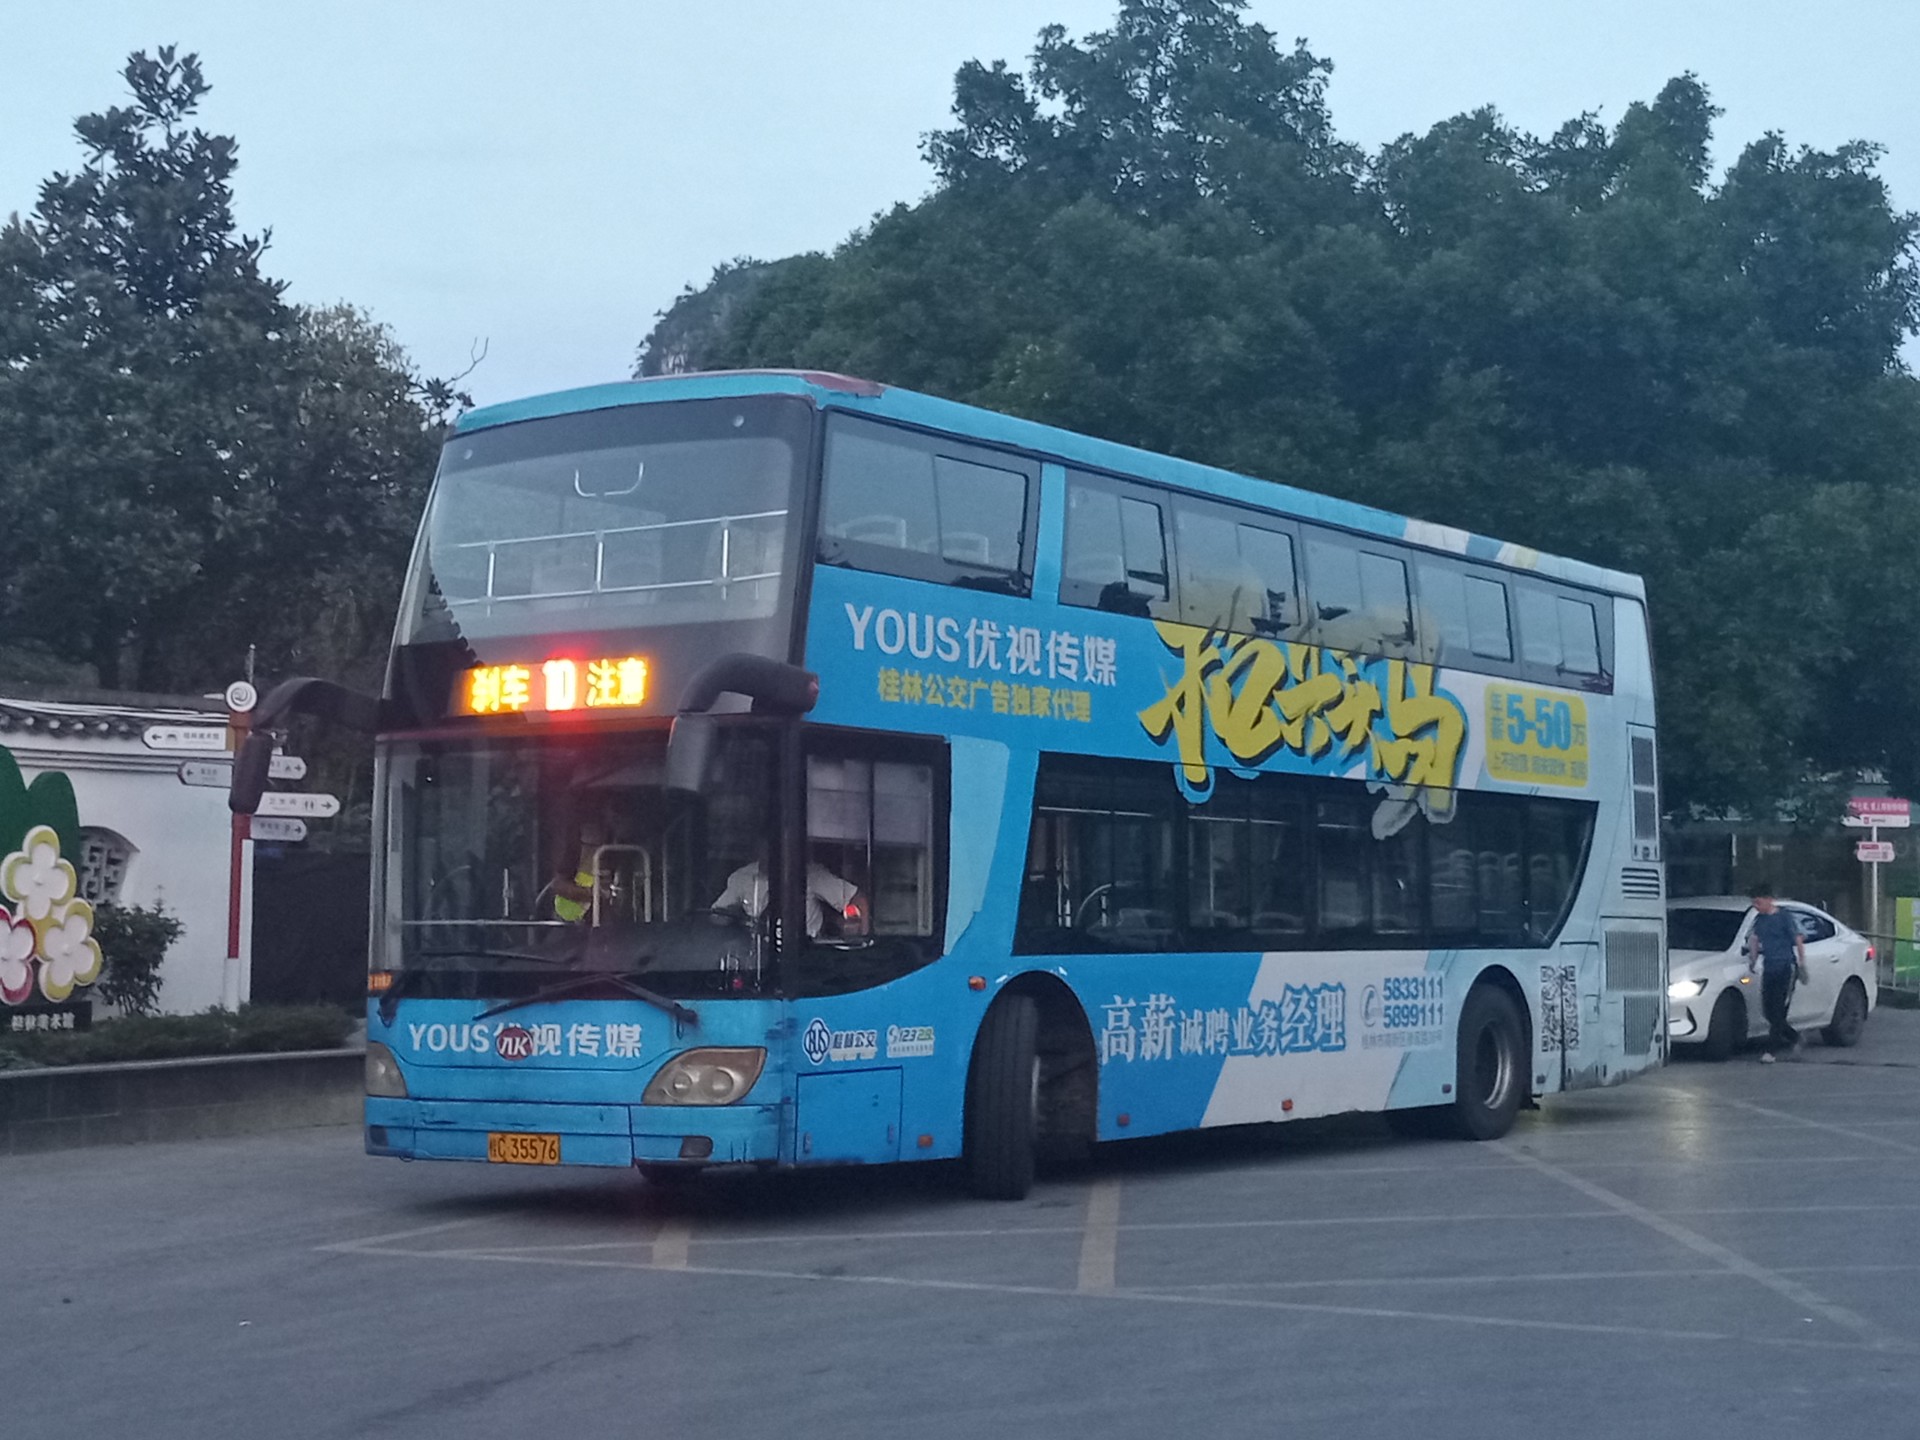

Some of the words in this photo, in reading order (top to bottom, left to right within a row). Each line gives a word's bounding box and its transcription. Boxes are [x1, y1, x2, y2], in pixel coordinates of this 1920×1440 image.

[844, 602, 1117, 687] YOUS优视传媒
[472, 664, 530, 712] 刹车
[585, 657, 647, 706] 注意
[877, 666, 1092, 722] 桂林公交广告独家代理
[1383, 976, 1443, 1001] 5833111
[1383, 1003, 1443, 1029] 5899111
[1101, 982, 1346, 1066] 高薪诚聘业务经理
